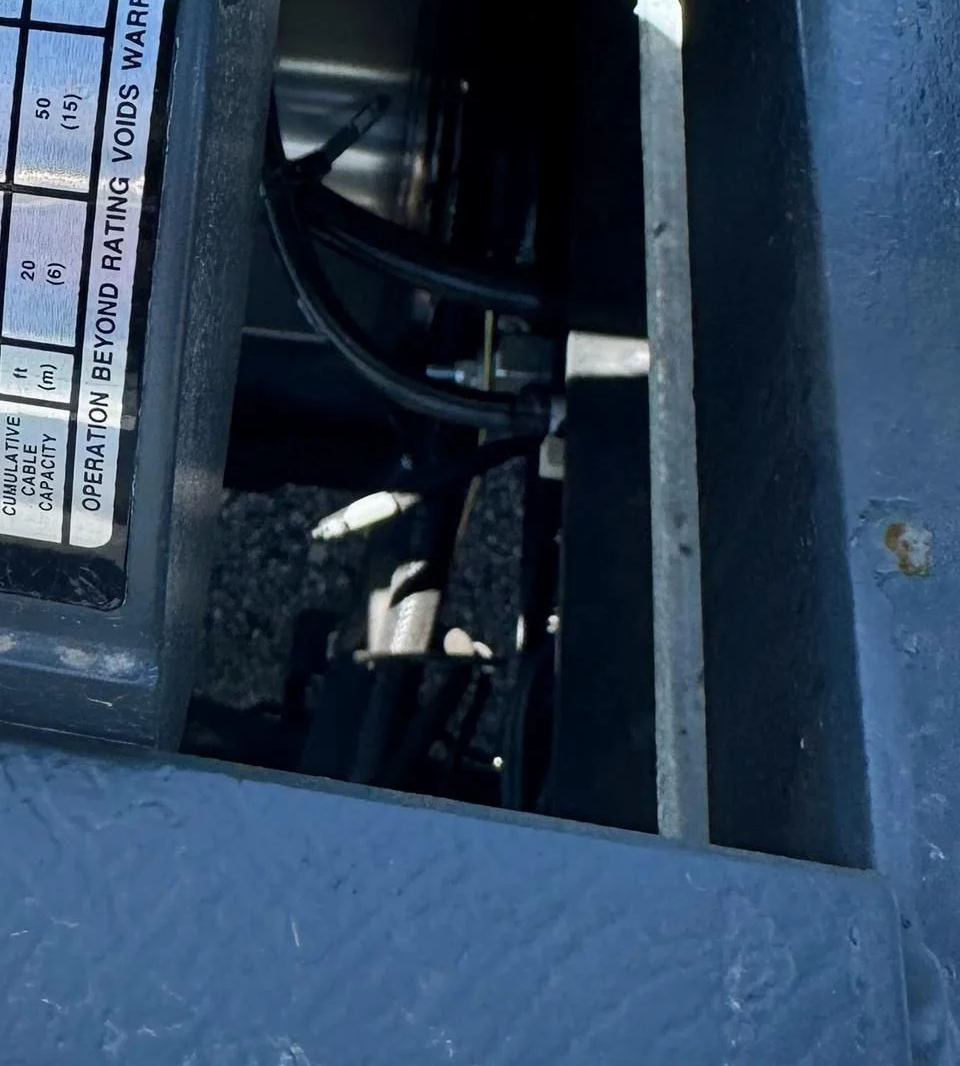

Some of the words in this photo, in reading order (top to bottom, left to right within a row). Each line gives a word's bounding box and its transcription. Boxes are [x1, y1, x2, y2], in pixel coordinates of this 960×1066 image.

[35, 97, 51, 120] 50
[60, 93, 83, 131] (15)
[112, 83, 140, 165] VOIDS
[100, 176, 130, 273] RATING
[20, 260, 36, 281] 20
[46, 261, 66, 287] (6)
[91, 286, 119, 382] BEYOND
[12, 366, 28, 380] ft
[38, 363, 58, 391] (m)
[2, 414, 21, 517] CUMULATIVE
[20, 443, 38, 497] CABLE
[38, 432, 58, 512] CAPACITY
[82, 391, 110, 512] OPERATION
